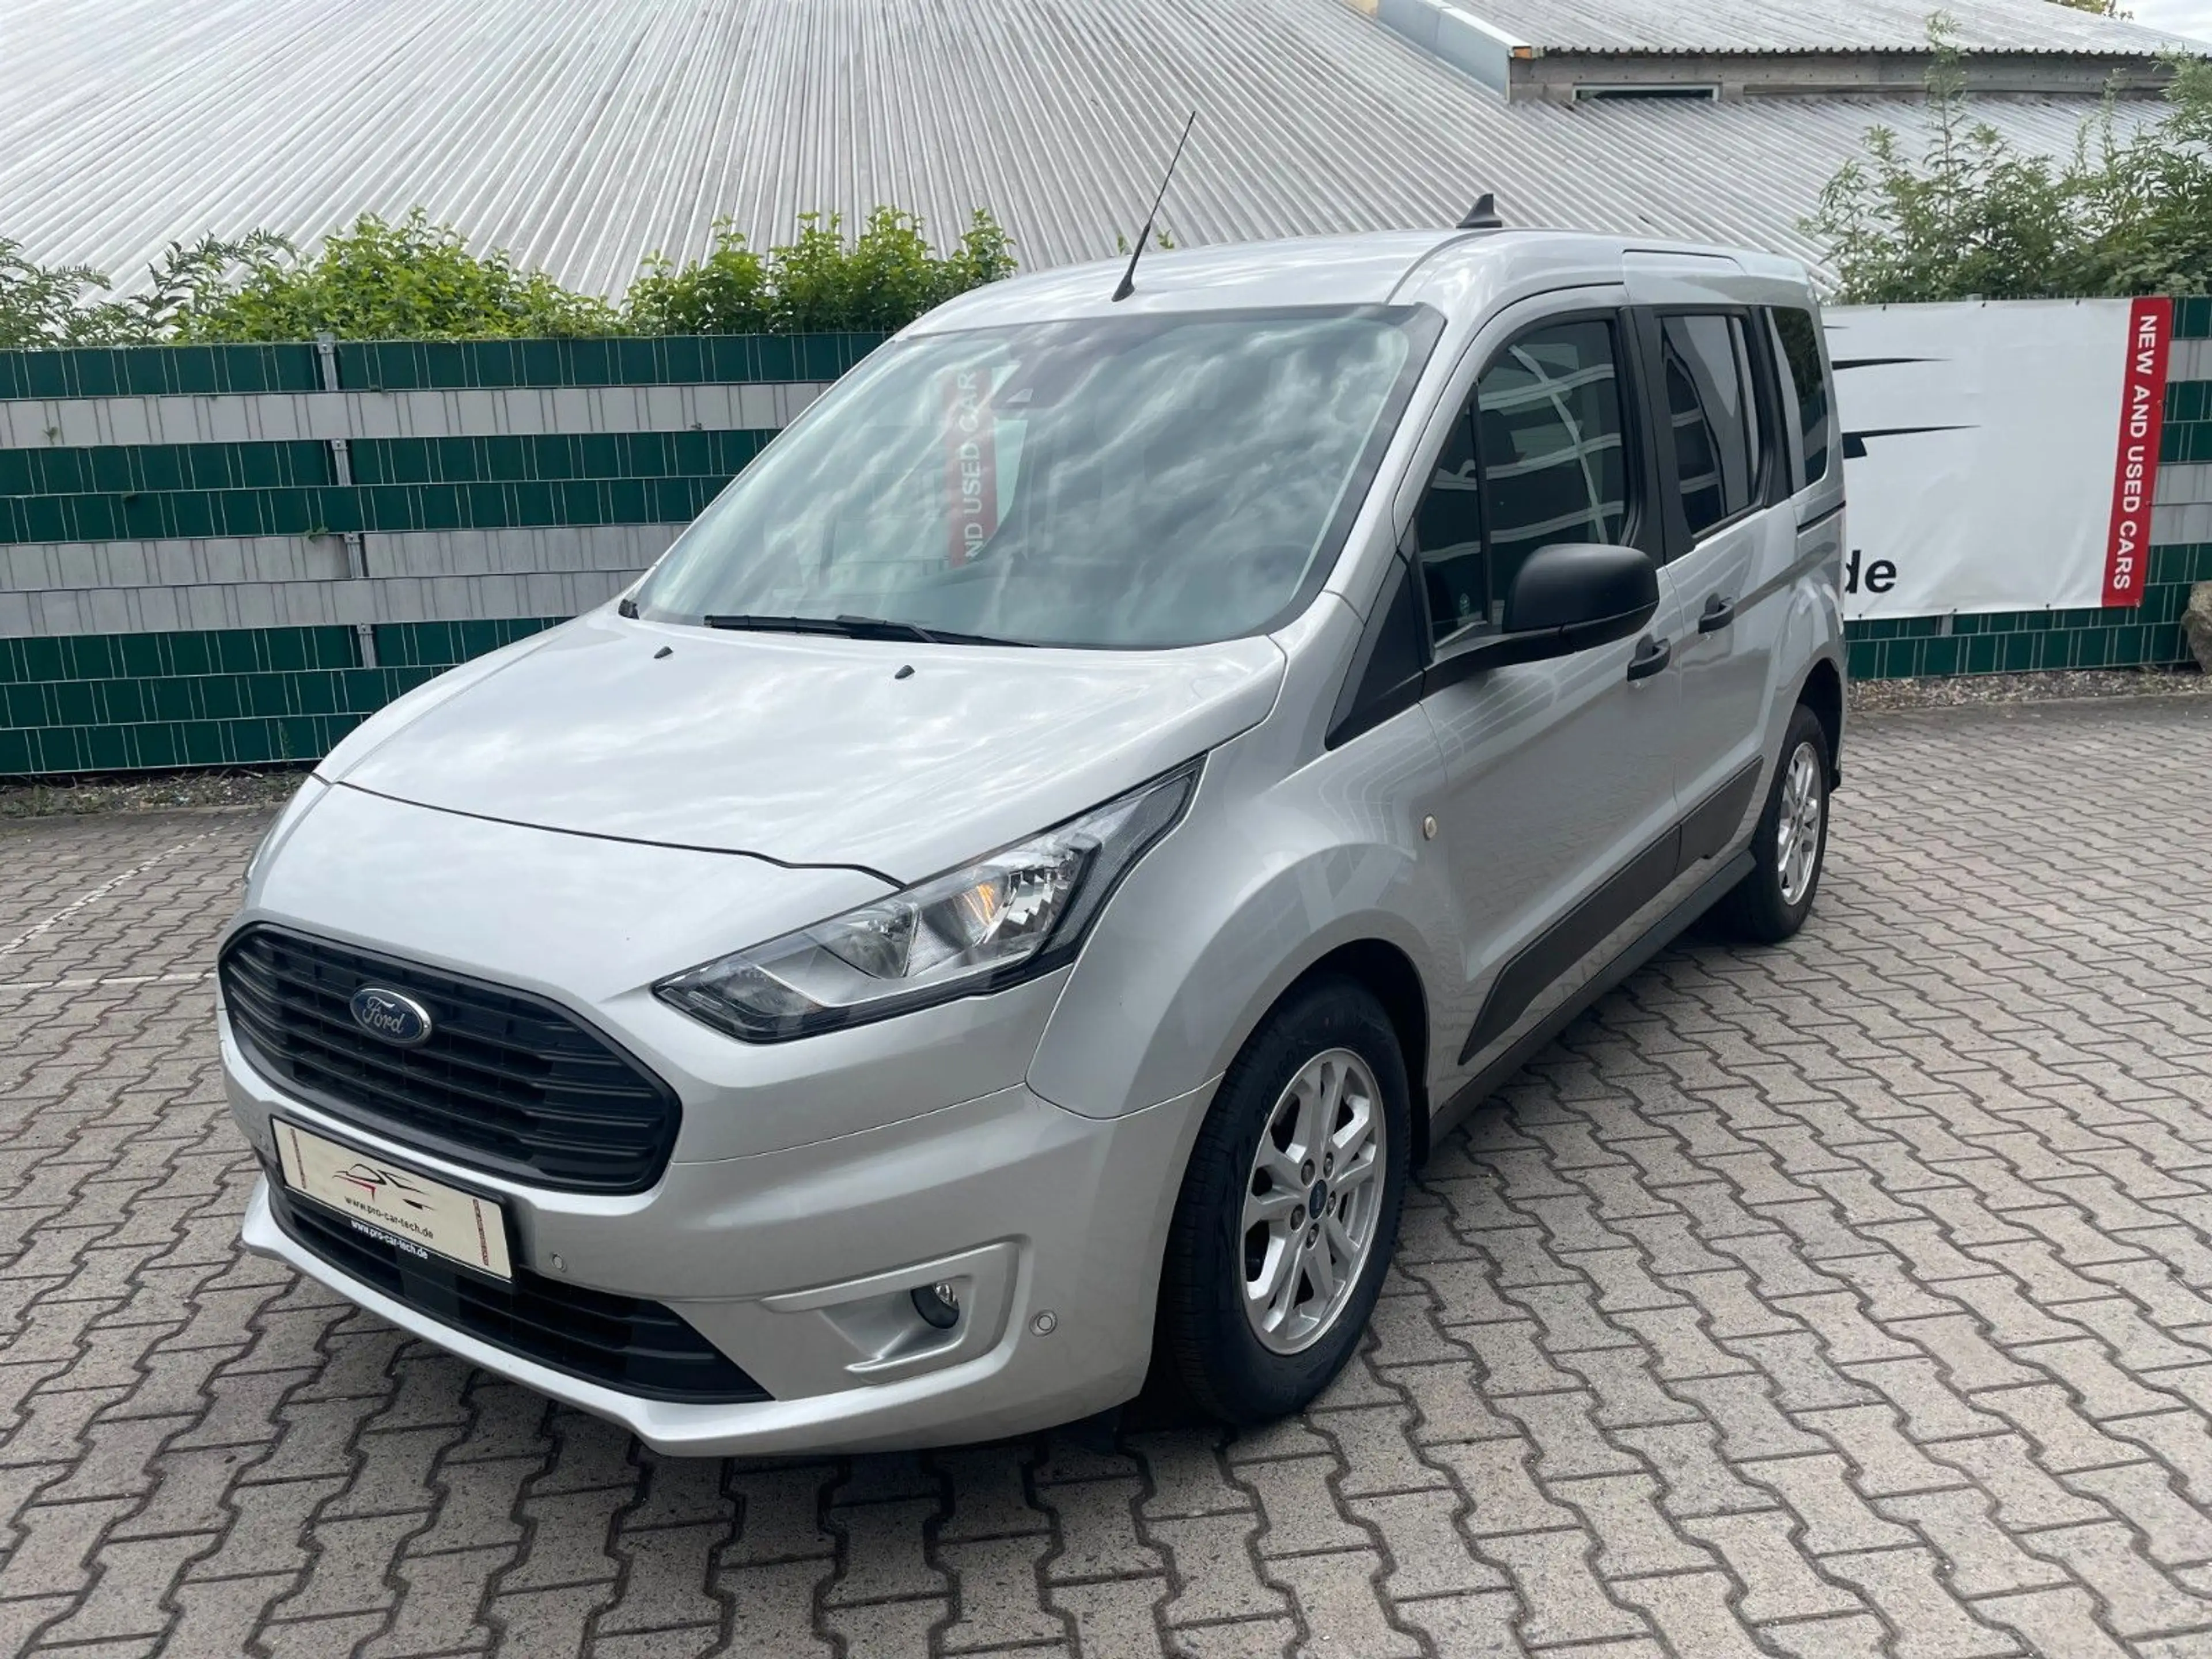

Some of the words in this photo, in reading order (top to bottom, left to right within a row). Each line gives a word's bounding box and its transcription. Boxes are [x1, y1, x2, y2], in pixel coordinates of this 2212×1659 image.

[2135, 315, 2158, 374] NEW
[957, 370, 980, 433] CAR
[2130, 384, 2150, 438] AND
[960, 441, 982, 514] USED
[2123, 445, 2145, 513] USED
[964, 523, 983, 559] ND
[2113, 520, 2137, 590] CARS
[362, 996, 406, 1033] Ford
[344, 1196, 434, 1239] www.pro-car-tech.de
[351, 1219, 429, 1260] www.pro-car-tech.de
